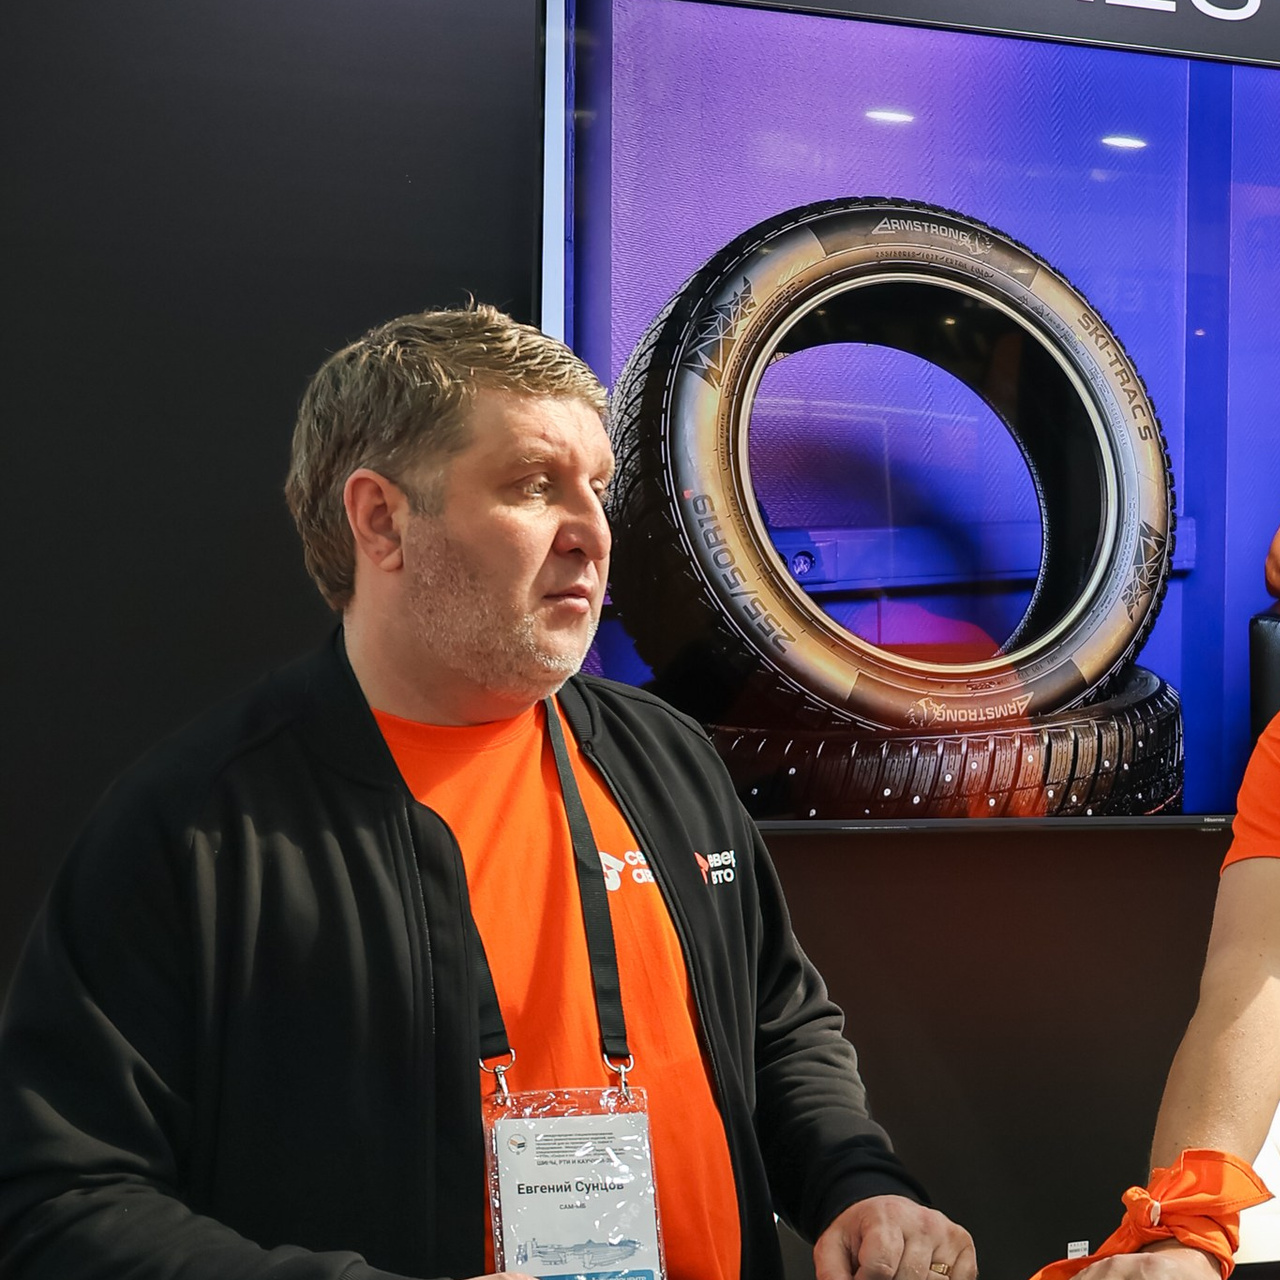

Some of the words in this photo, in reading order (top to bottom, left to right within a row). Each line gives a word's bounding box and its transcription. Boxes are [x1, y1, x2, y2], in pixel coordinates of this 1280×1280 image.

[871, 217, 969, 241] ARMSTRONG
[692, 494, 797, 654] 255/50R19
[517, 1181, 572, 1195] Евгений
[575, 1181, 624, 1195] Сунцов
